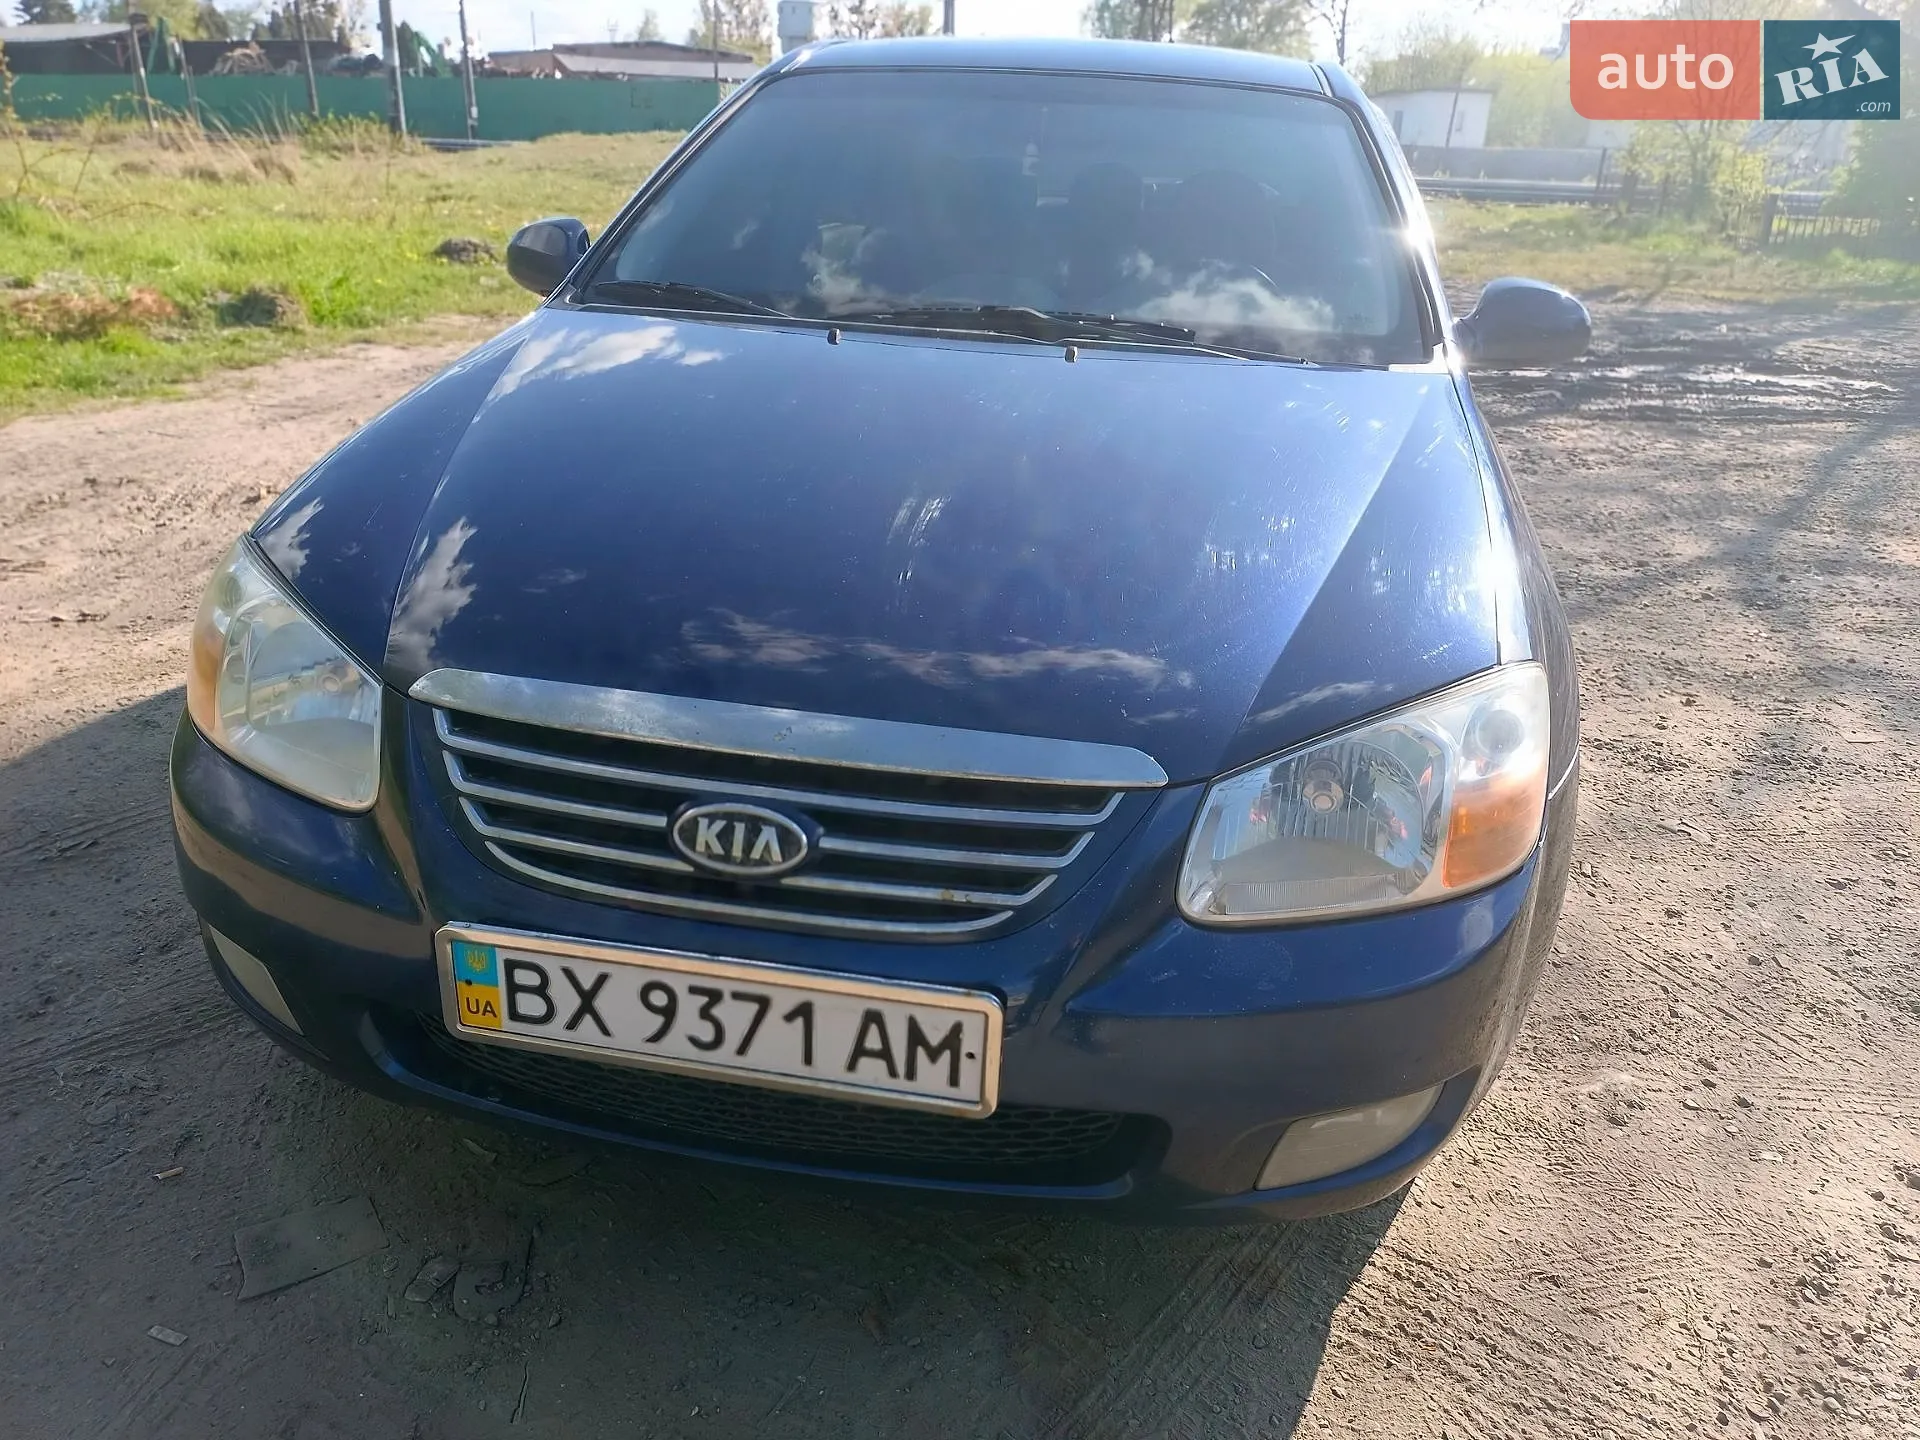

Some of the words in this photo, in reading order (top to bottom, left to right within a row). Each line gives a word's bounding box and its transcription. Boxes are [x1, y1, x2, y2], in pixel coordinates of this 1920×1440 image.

[696, 817, 783, 863] KIA
[465, 998, 497, 1018] UA
[503, 958, 613, 1037] BX
[638, 980, 814, 1067] 9371
[846, 1008, 964, 1088] AM
